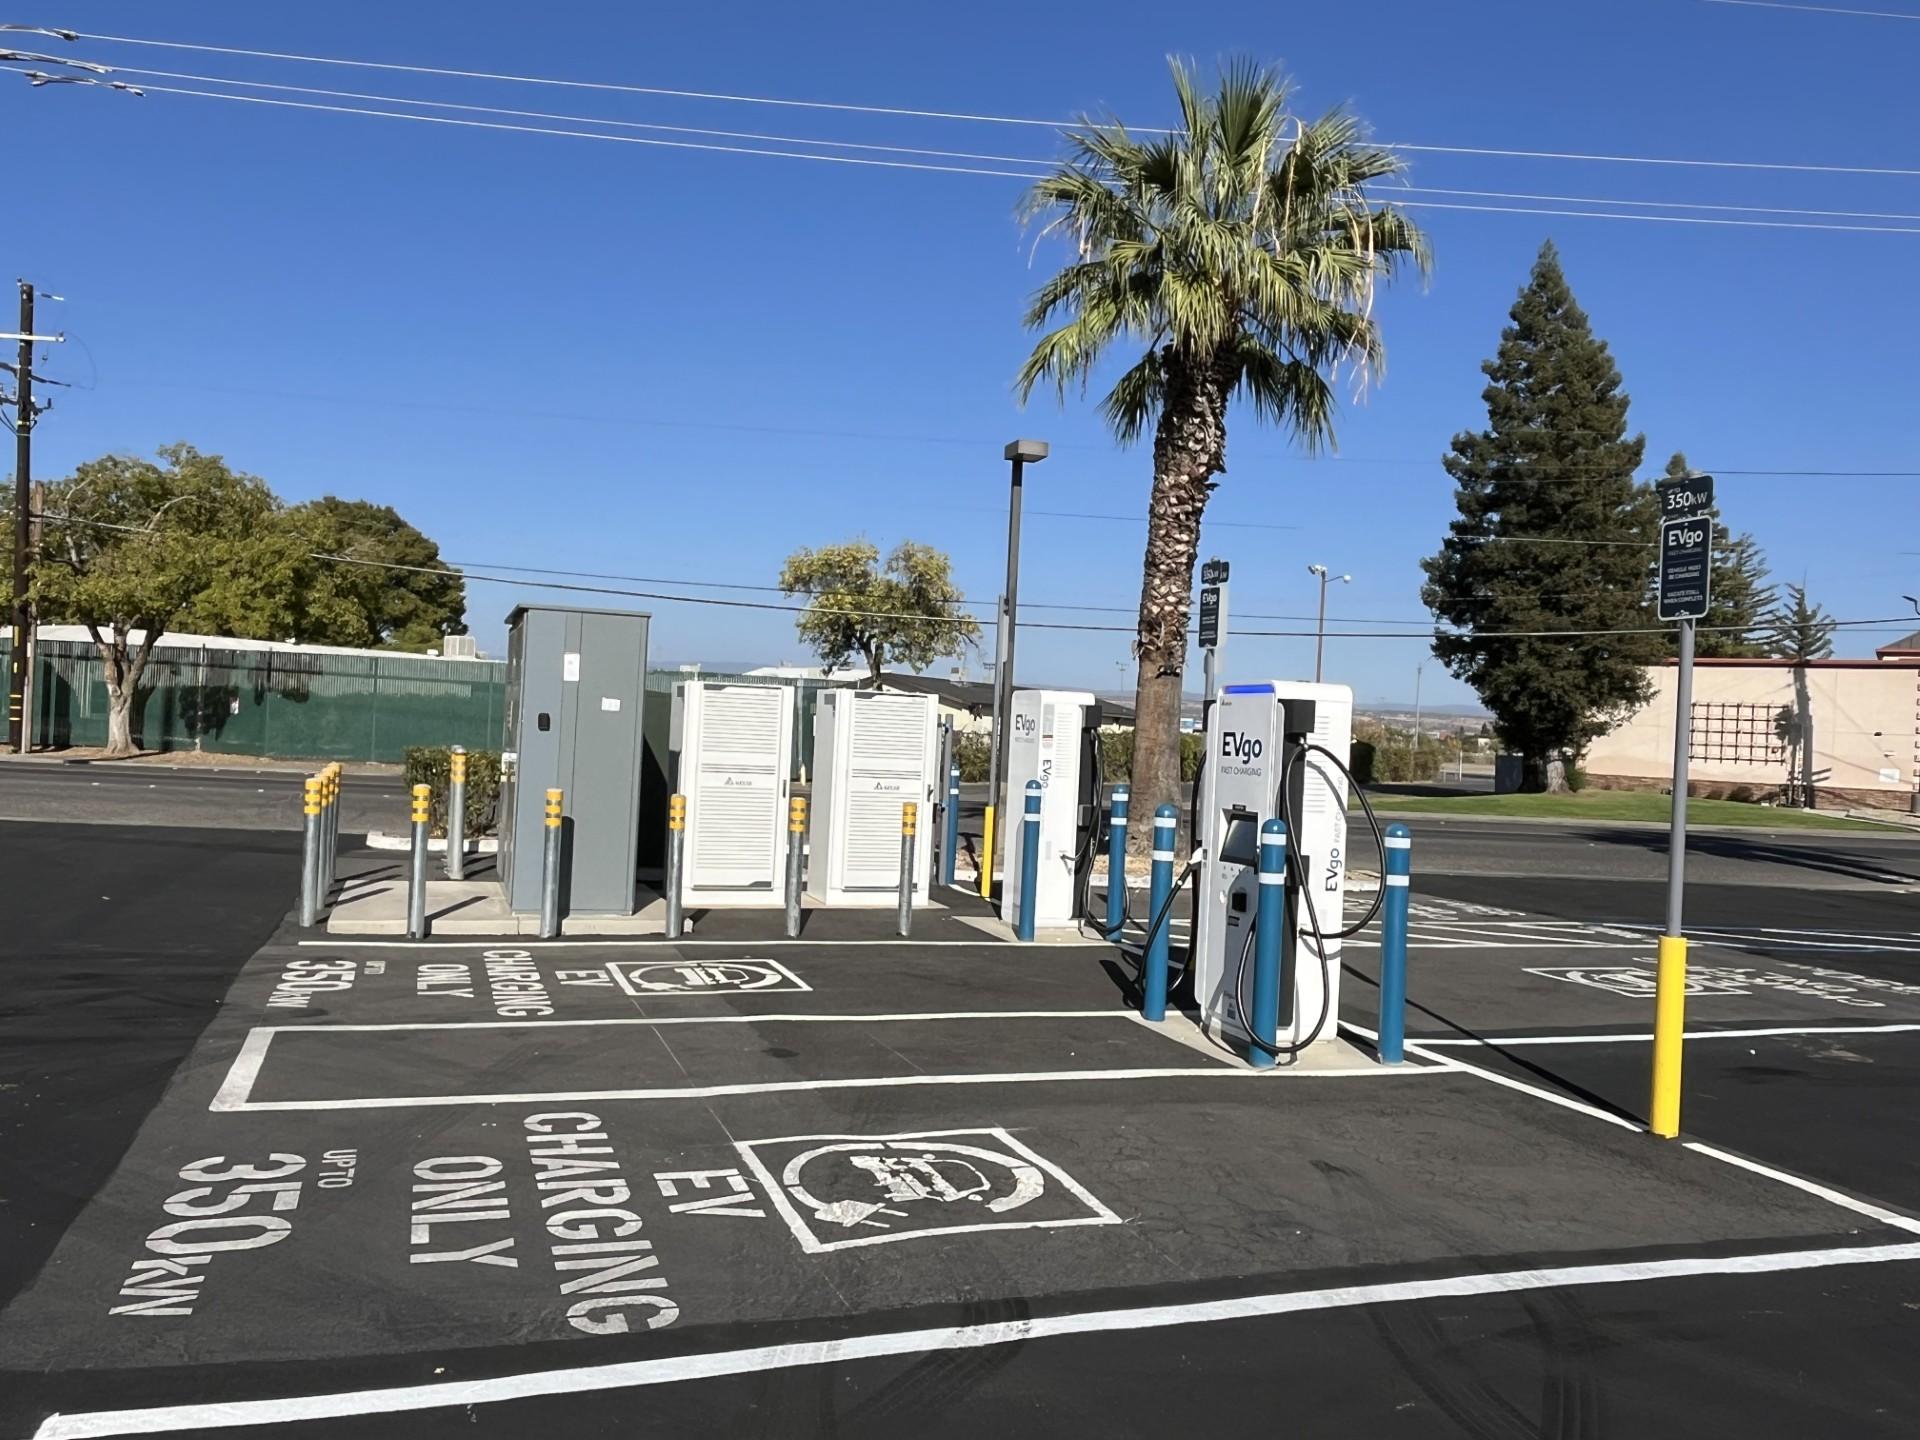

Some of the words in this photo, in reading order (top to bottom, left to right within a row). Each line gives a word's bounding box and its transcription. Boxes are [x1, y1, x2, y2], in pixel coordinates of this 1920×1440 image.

[1667, 491, 1708, 510] 350kW
[1668, 528, 1704, 548] EVgo
[1015, 713, 1036, 737] EVgo
[1221, 731, 1263, 765] EVgo
[1040, 759, 1052, 789] EVgo
[1325, 848, 1343, 892] EVgo
[416, 963, 475, 998] ONLY
[482, 950, 555, 1017] CHARGING
[554, 970, 614, 987] EV
[321, 1148, 358, 1171] UP
[653, 1168, 768, 1218] EV
[409, 1155, 519, 1269] ONLY
[523, 1111, 680, 1335] CHARGING
